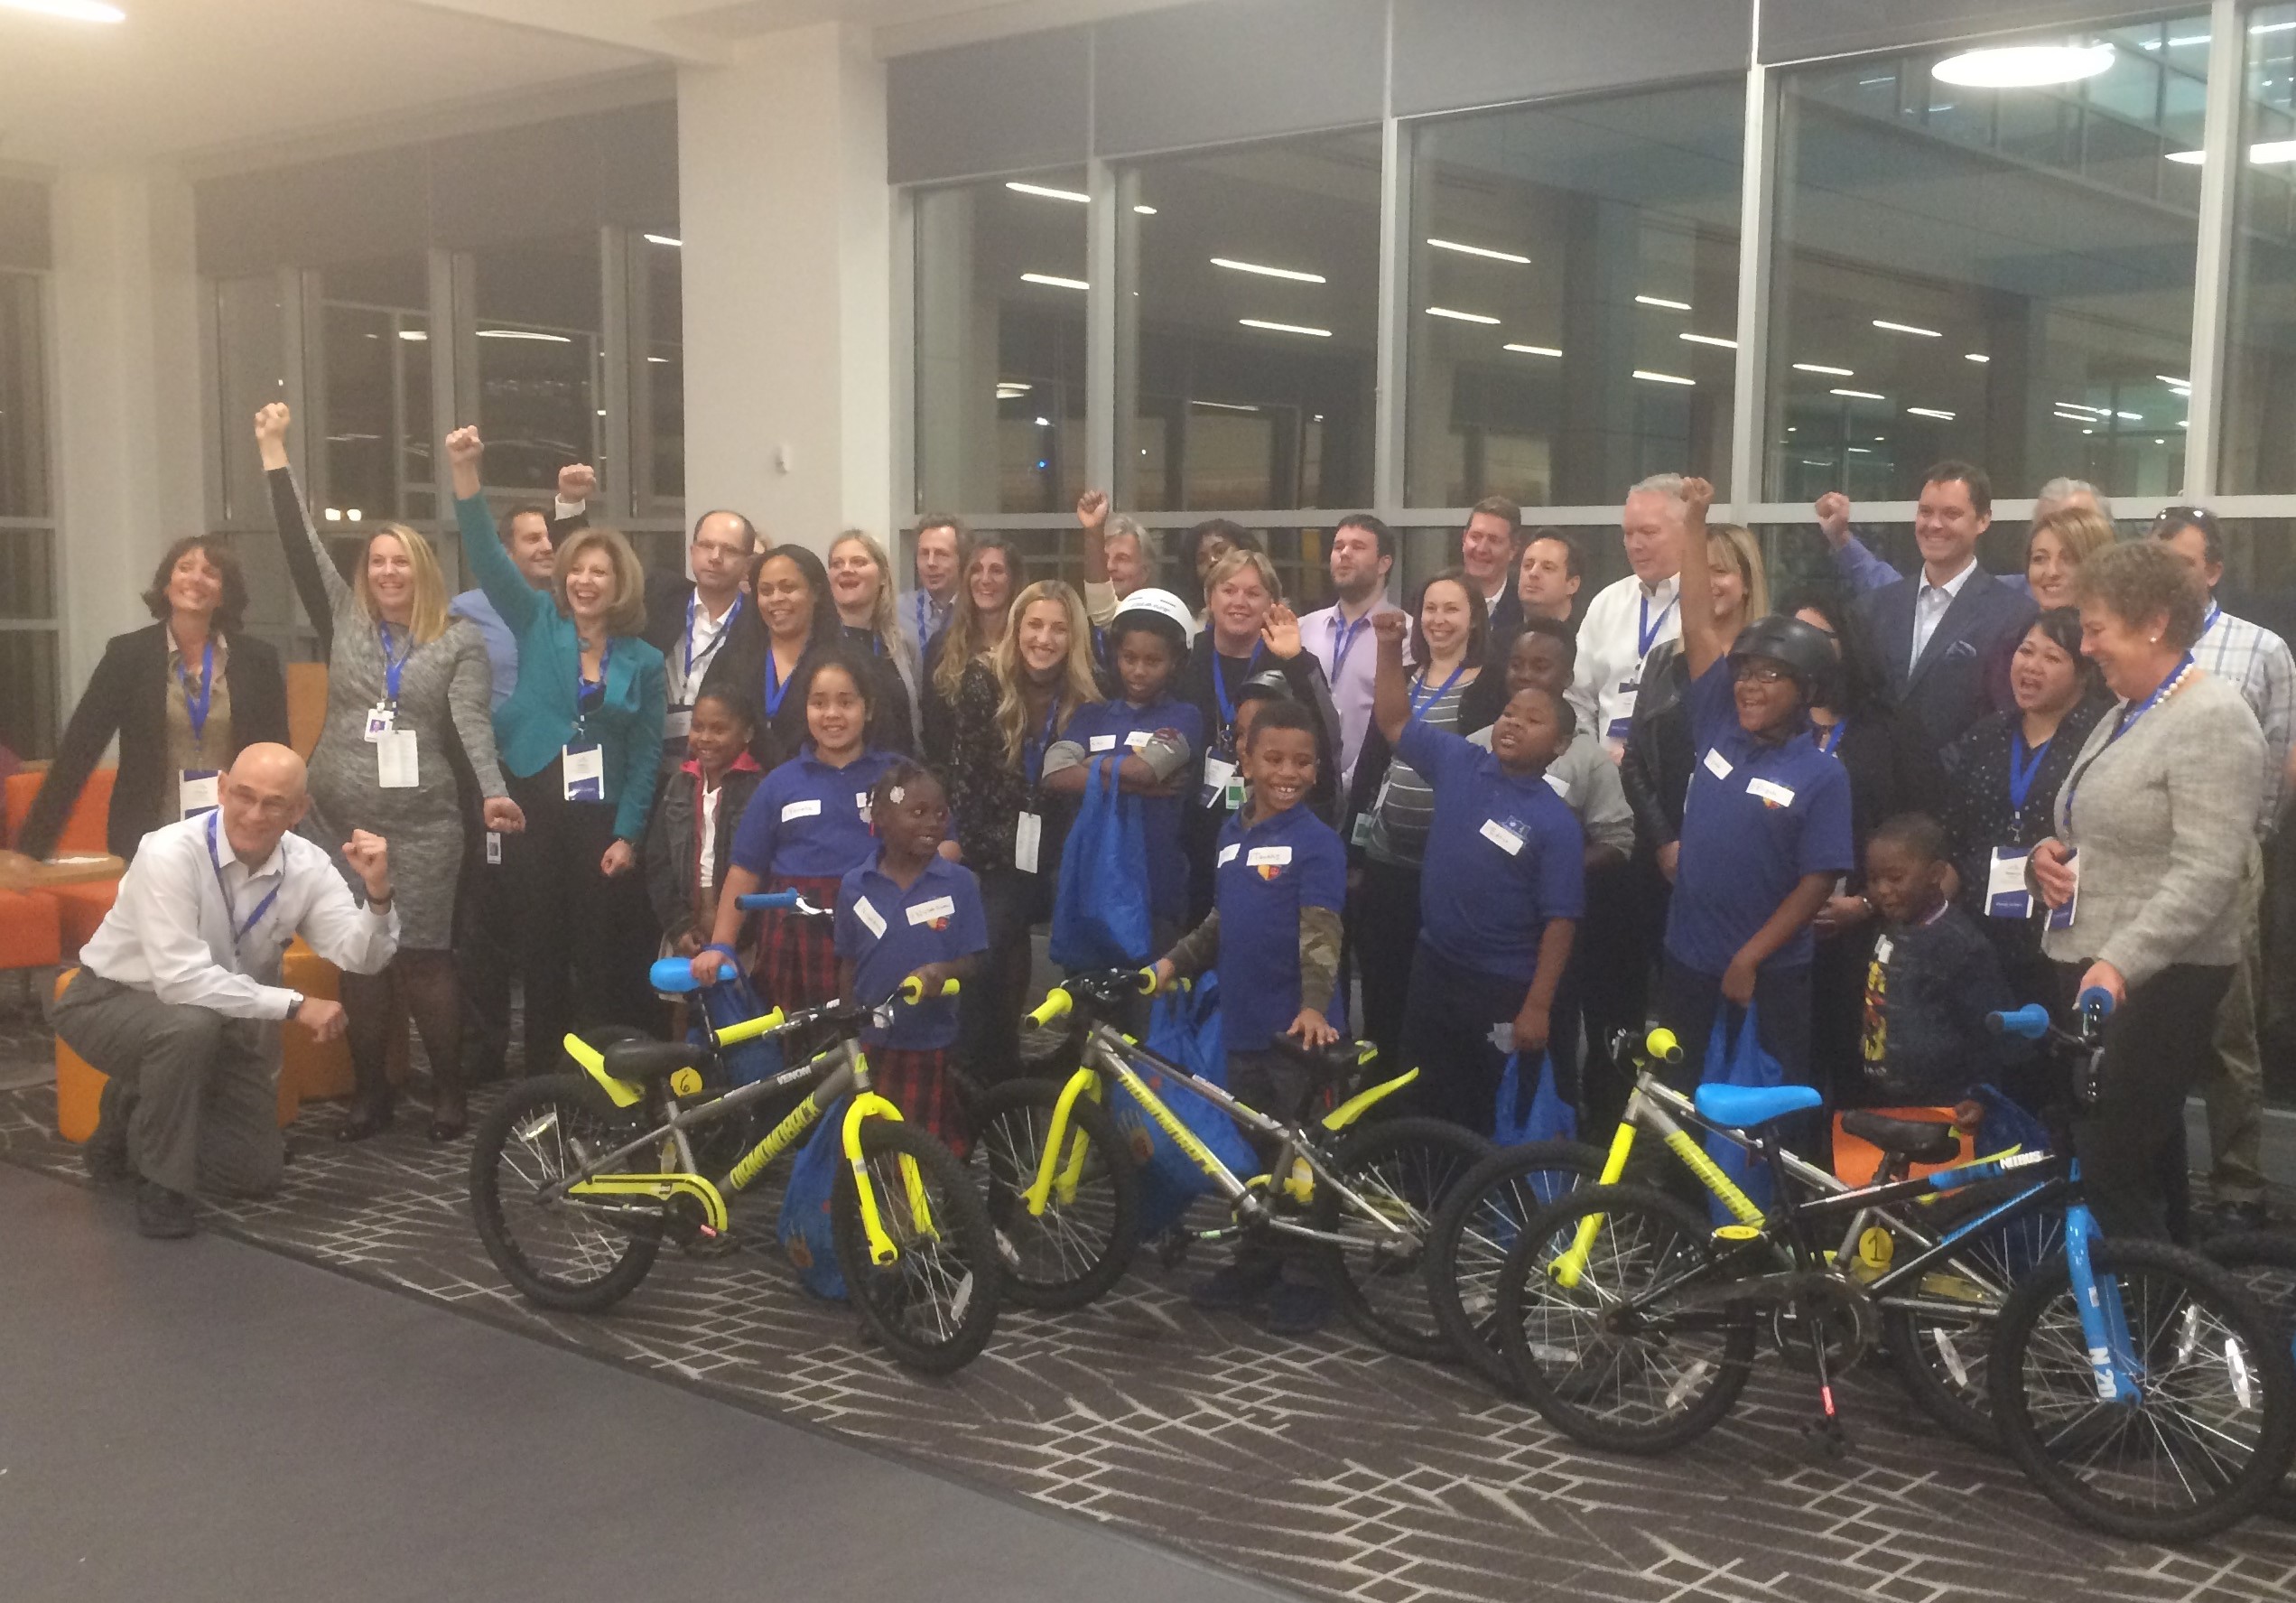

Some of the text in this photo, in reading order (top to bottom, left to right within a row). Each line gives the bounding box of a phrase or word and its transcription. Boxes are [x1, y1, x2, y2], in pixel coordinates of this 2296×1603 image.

[680, 1074, 690, 1092] 6
[777, 1066, 811, 1084] VENOM
[730, 1091, 821, 1191] DIAMONDBACK
[1867, 1235, 1884, 1262] 1
